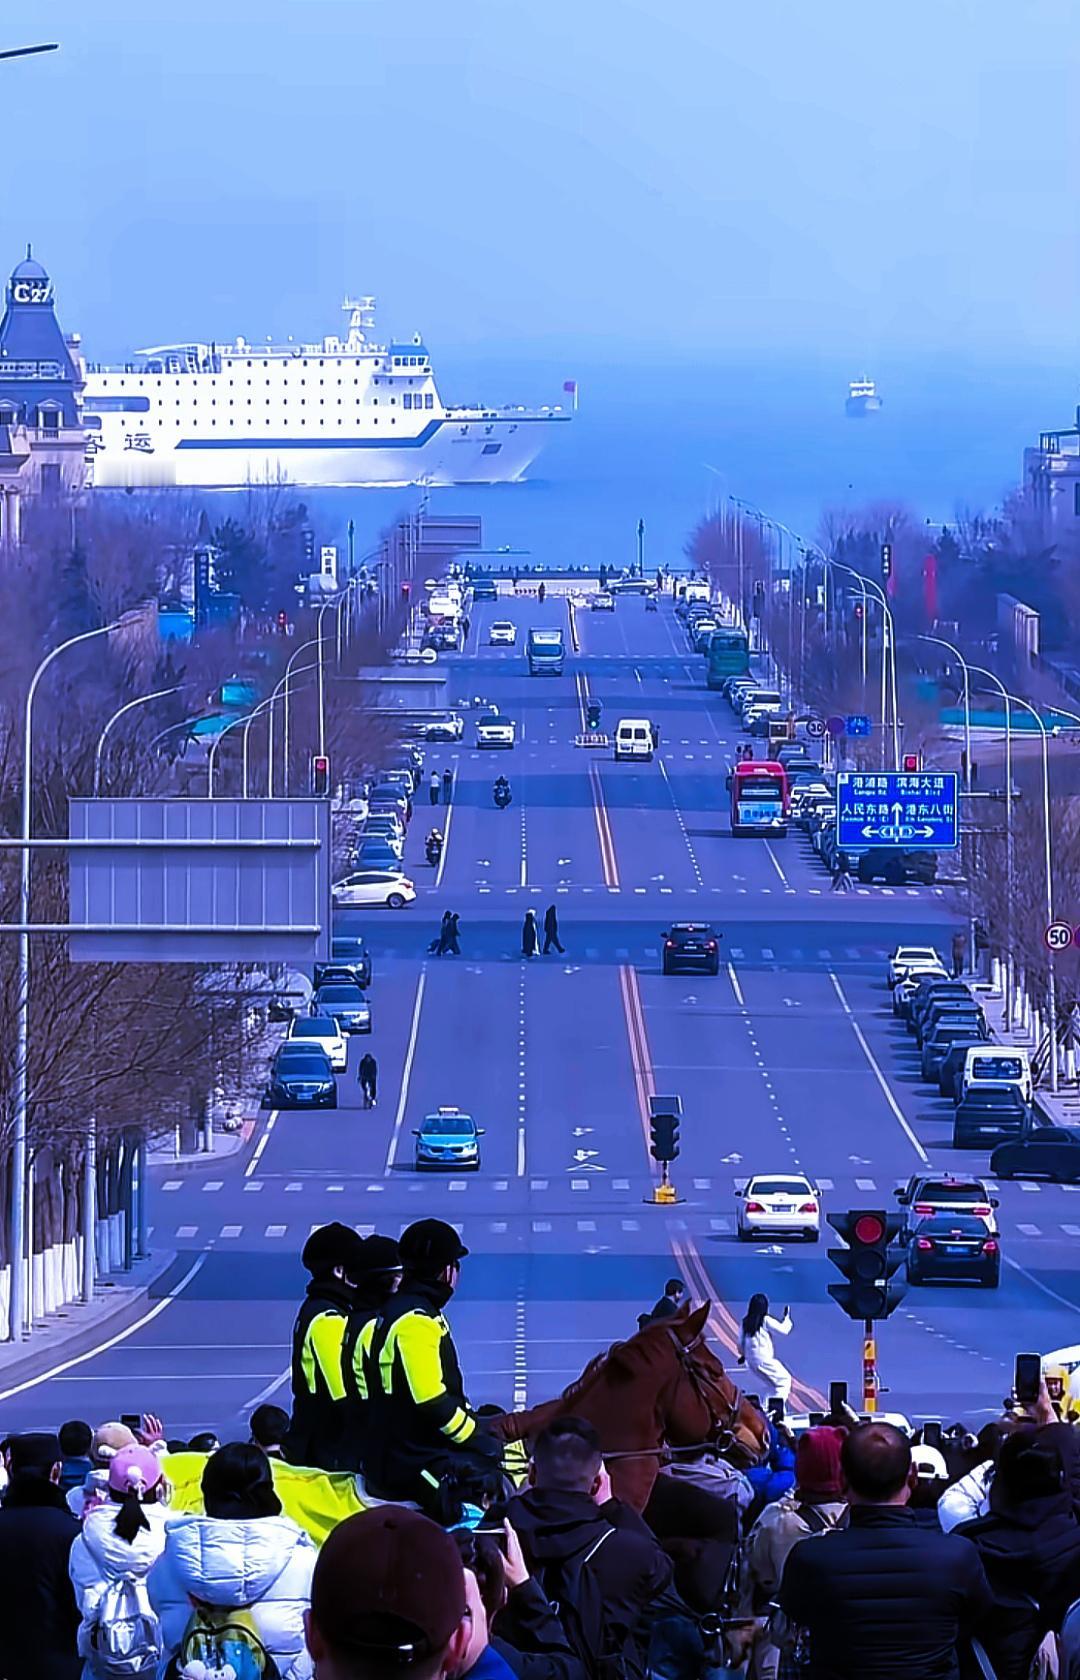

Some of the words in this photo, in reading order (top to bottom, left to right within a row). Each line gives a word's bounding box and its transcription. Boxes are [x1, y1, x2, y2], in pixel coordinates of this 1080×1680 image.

[841, 803, 889, 815] 人民东路
[1050, 929, 1068, 945] 50
